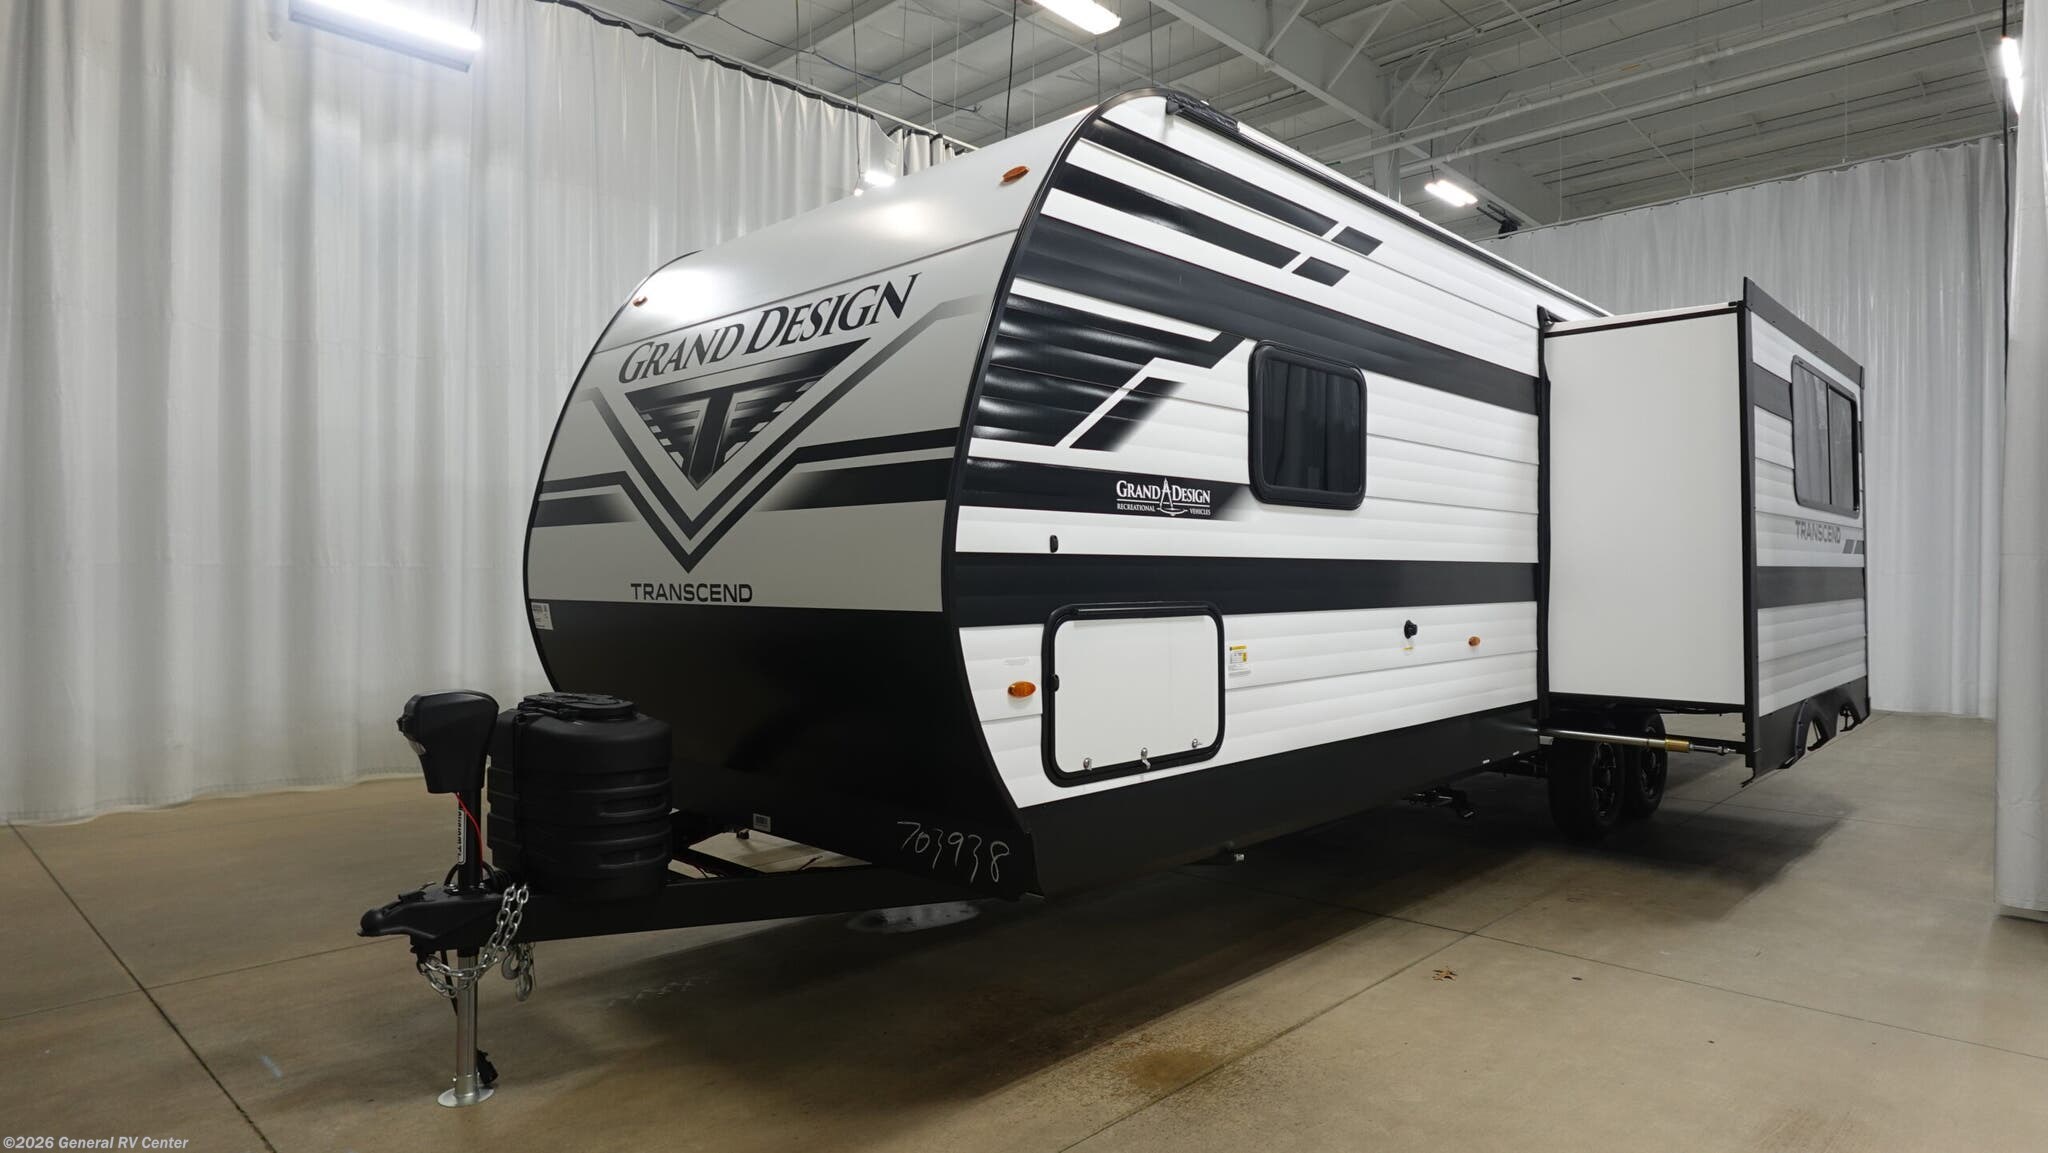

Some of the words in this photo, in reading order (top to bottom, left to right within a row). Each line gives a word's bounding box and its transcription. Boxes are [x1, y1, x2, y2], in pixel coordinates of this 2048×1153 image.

[618, 324, 744, 384] GRAND
[744, 272, 922, 355] DESIGN
[1116, 480, 1160, 500] GRAND
[1172, 485, 1210, 503] DESIGN
[1117, 503, 1155, 512] RECREATIONAL
[1795, 520, 1841, 543] TRANSCEND
[630, 583, 753, 603] TRANSCEND
[897, 821, 1010, 883] 703938
